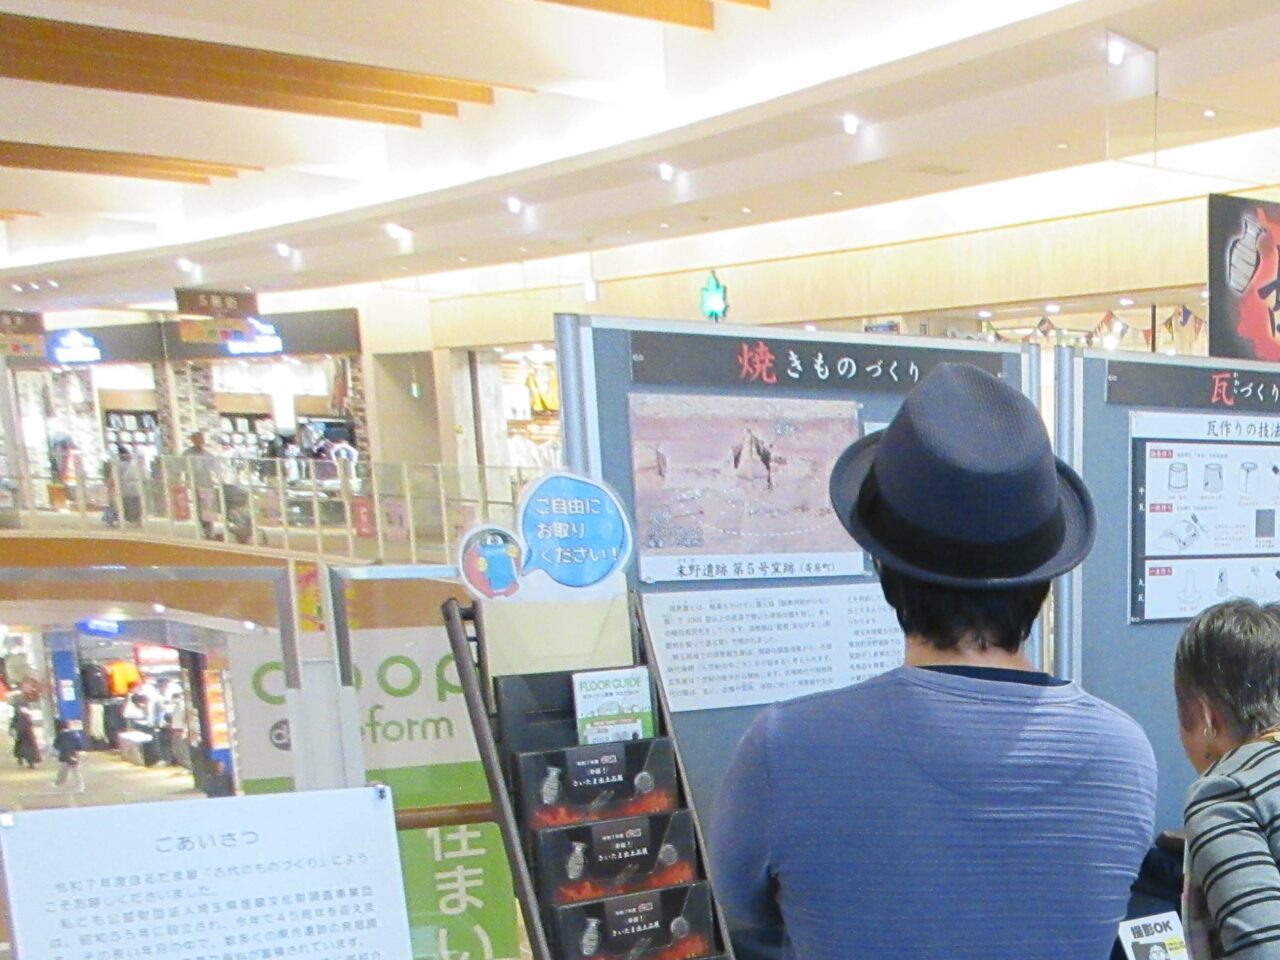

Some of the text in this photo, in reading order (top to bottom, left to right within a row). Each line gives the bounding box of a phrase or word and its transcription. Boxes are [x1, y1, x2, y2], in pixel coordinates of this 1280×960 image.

[737, 341, 921, 386] 焼きものづくり
[1211, 372, 1280, 406] 瓦づくり
[536, 497, 601, 515] ご自由に
[536, 521, 586, 540] お取り
[540, 546, 618, 564] ください！
[676, 562, 728, 577] 末野遺跡
[1130, 920, 1173, 939] 撮影OK
